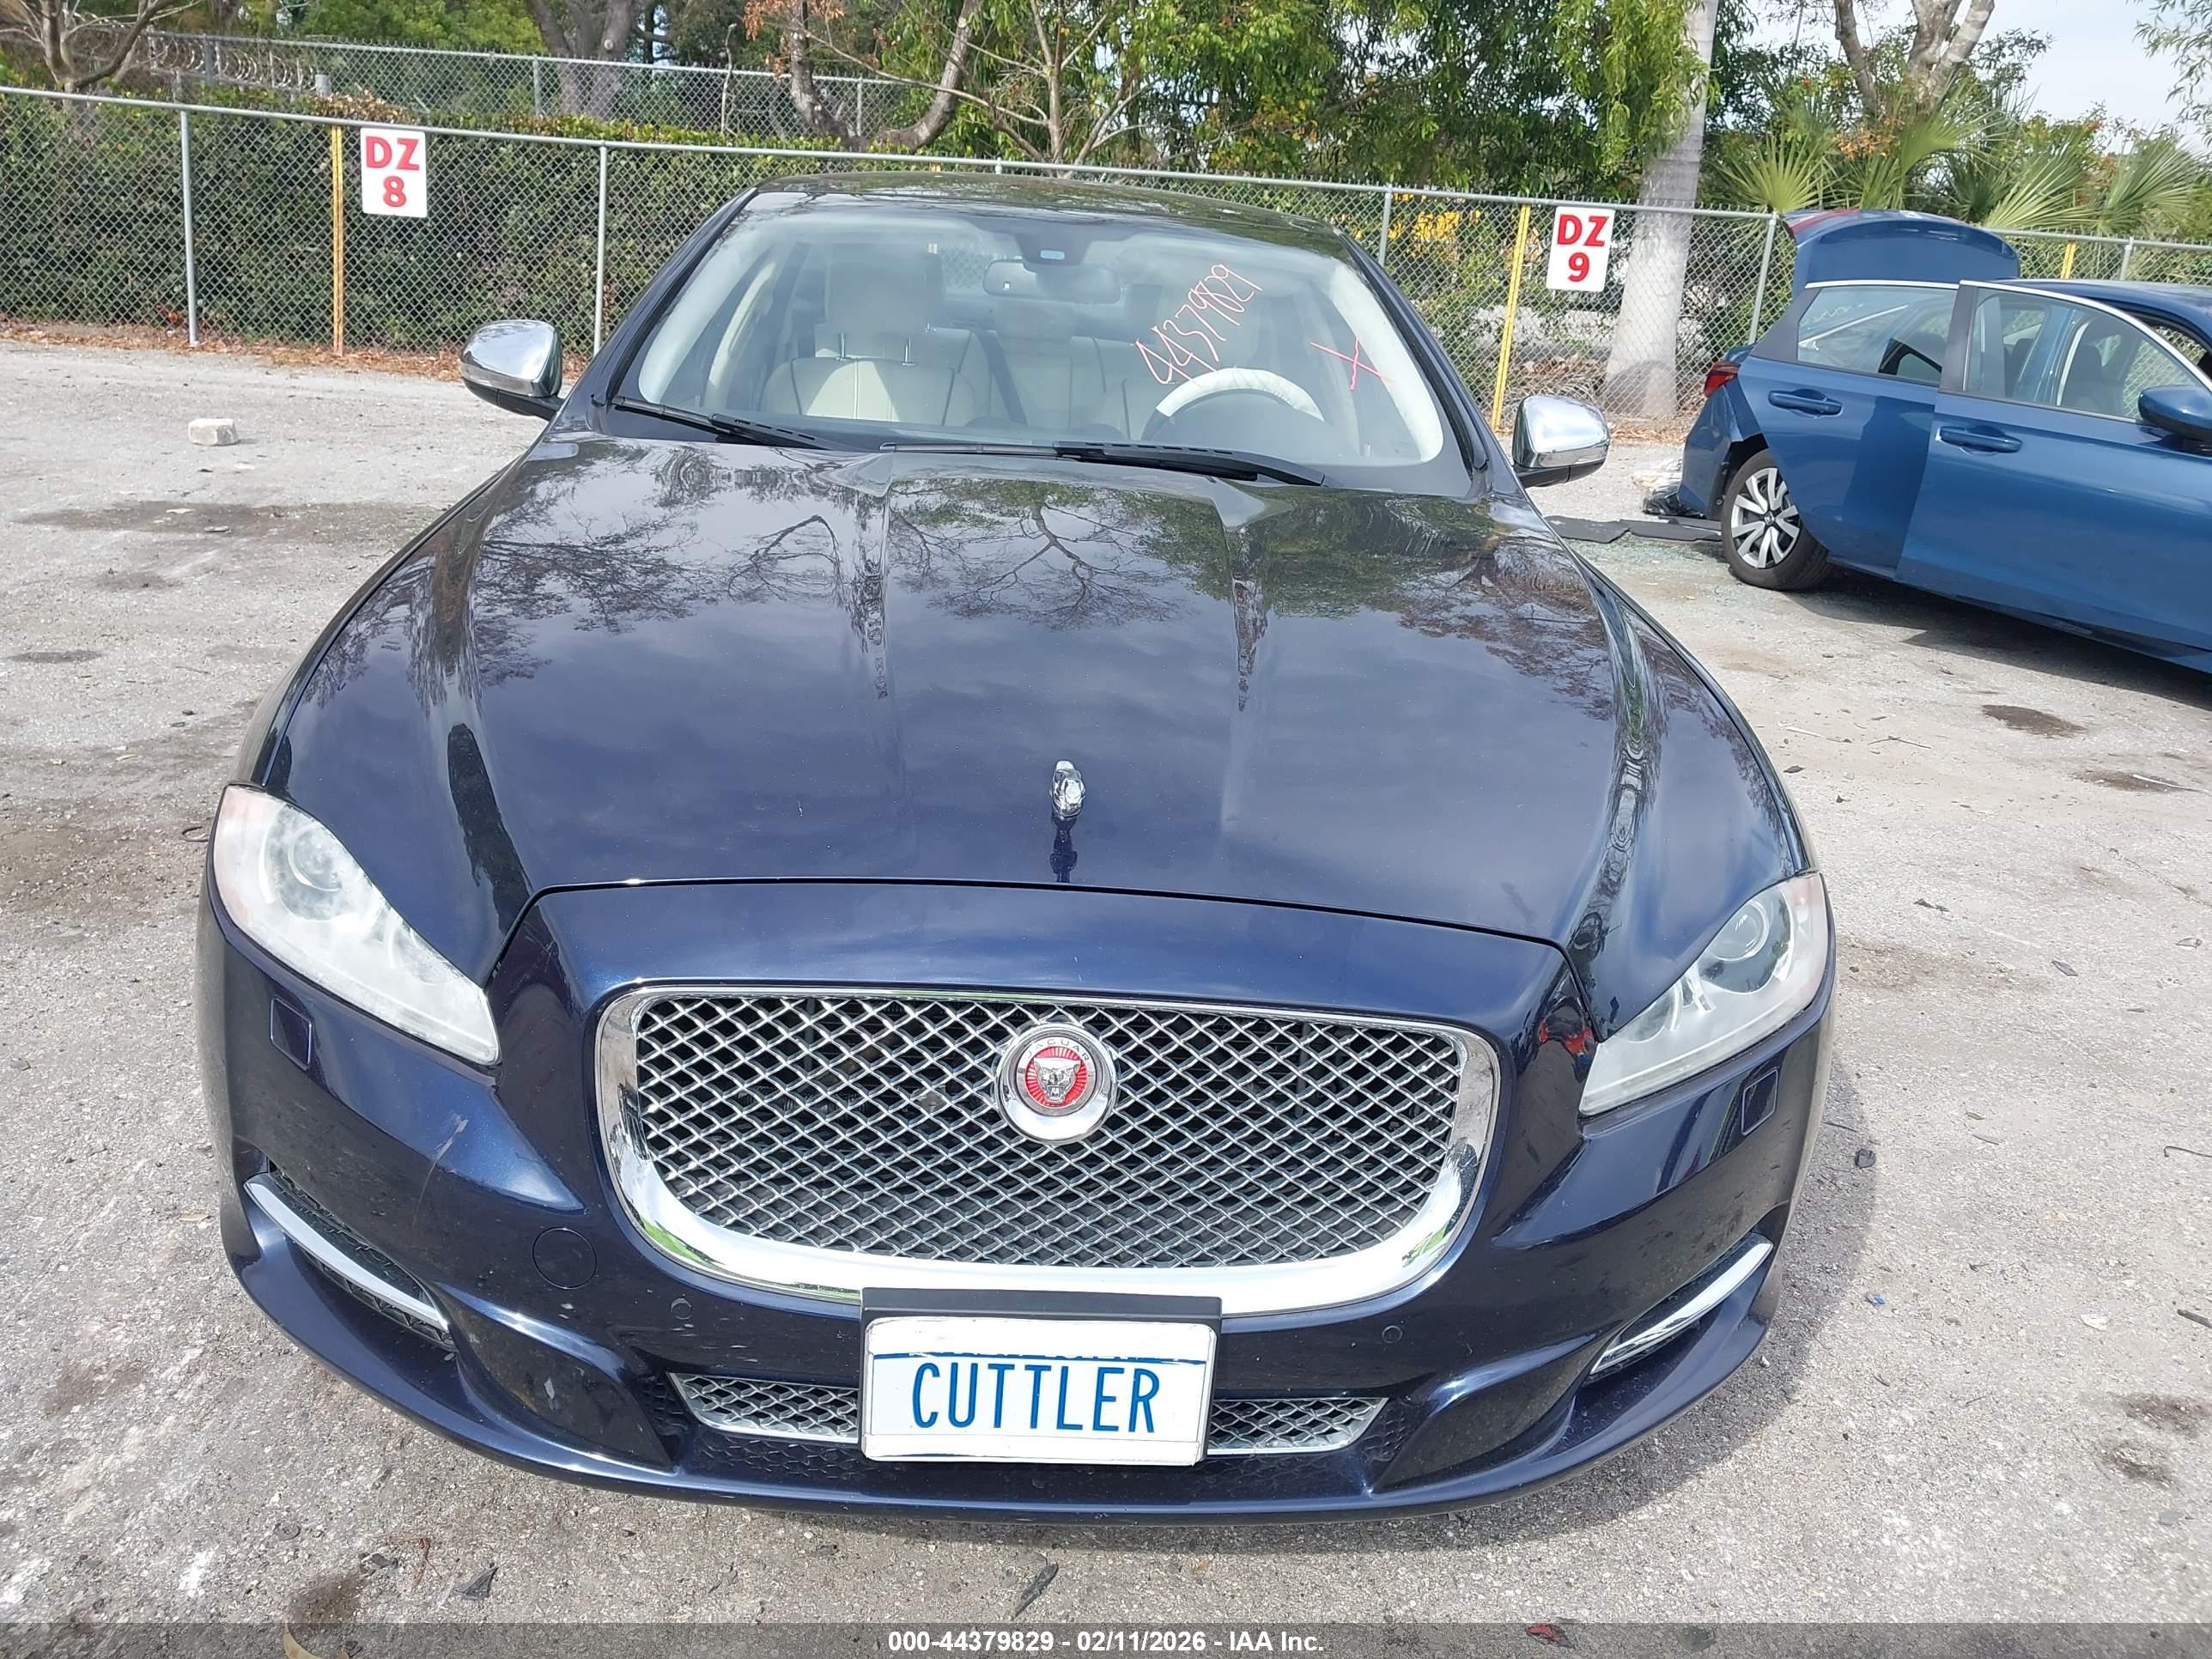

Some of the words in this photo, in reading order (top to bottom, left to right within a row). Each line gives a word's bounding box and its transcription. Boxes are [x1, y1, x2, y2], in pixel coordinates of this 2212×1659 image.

[365, 136, 420, 171] DZ
[383, 175, 407, 208] 8
[1557, 214, 1609, 247] DZ
[1567, 252, 1590, 283] 9
[1132, 264, 1263, 387] 44379829
[912, 1362, 1160, 1433] CUTTLER
